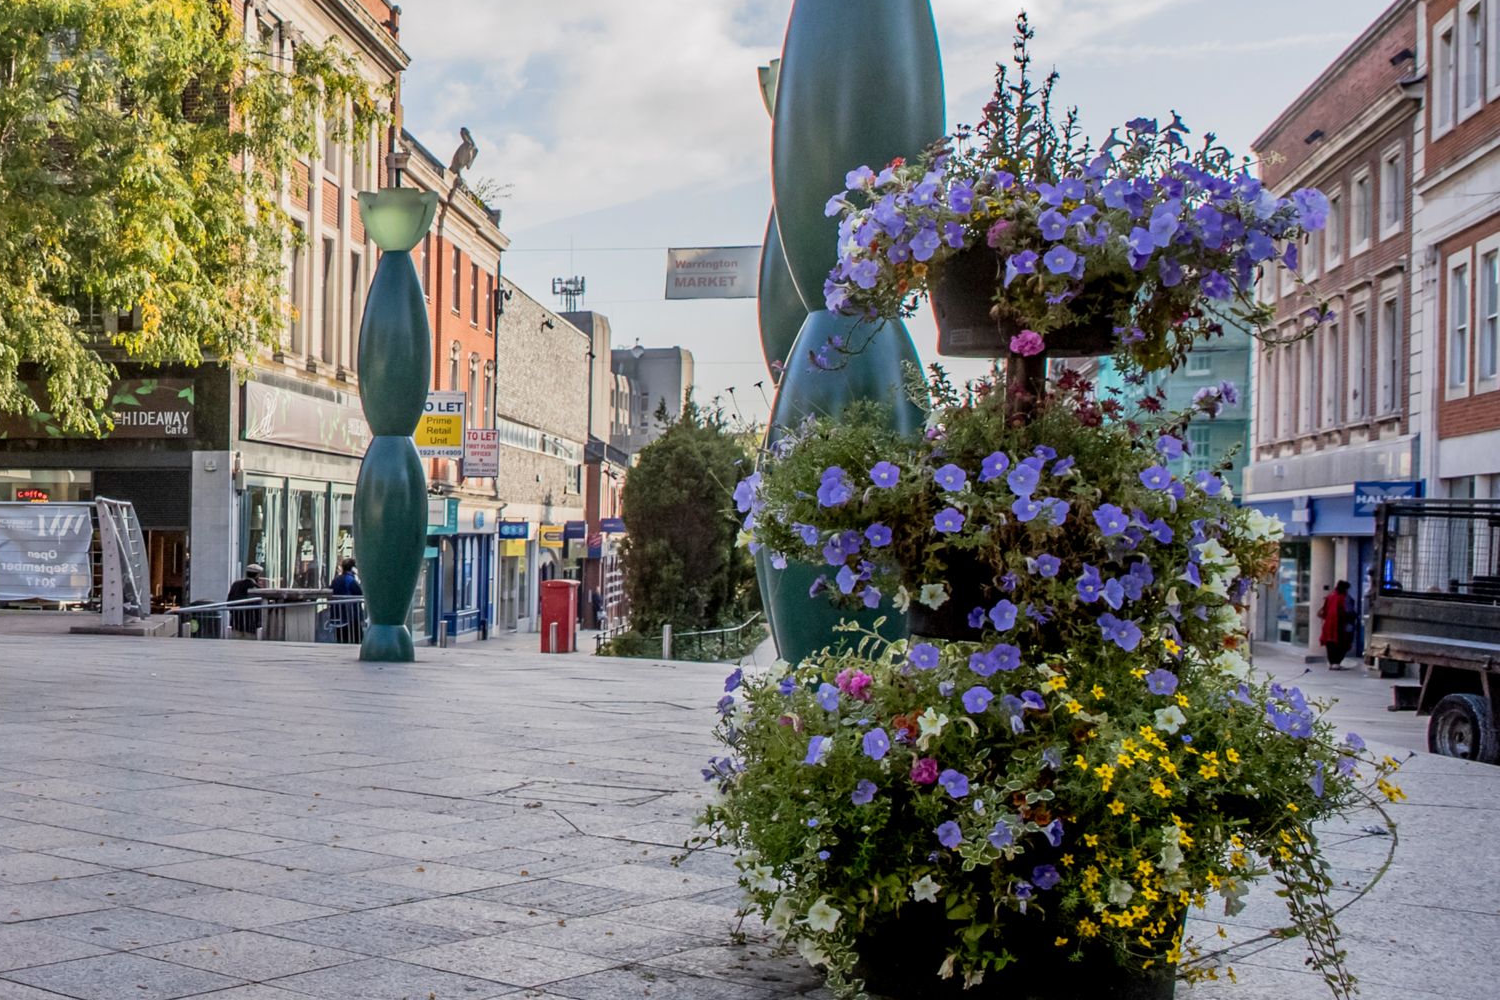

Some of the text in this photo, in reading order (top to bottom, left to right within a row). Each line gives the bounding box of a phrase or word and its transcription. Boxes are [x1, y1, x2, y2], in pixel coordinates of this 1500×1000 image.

[675, 259, 738, 270] Warrington
[674, 276, 737, 287] MARKET
[438, 402, 463, 412] LET
[122, 411, 190, 426] HIDEAWAY
[426, 416, 452, 425] Prime
[426, 426, 452, 435] Retail
[430, 437, 448, 445] Unit
[467, 431, 497, 441] TO LET
